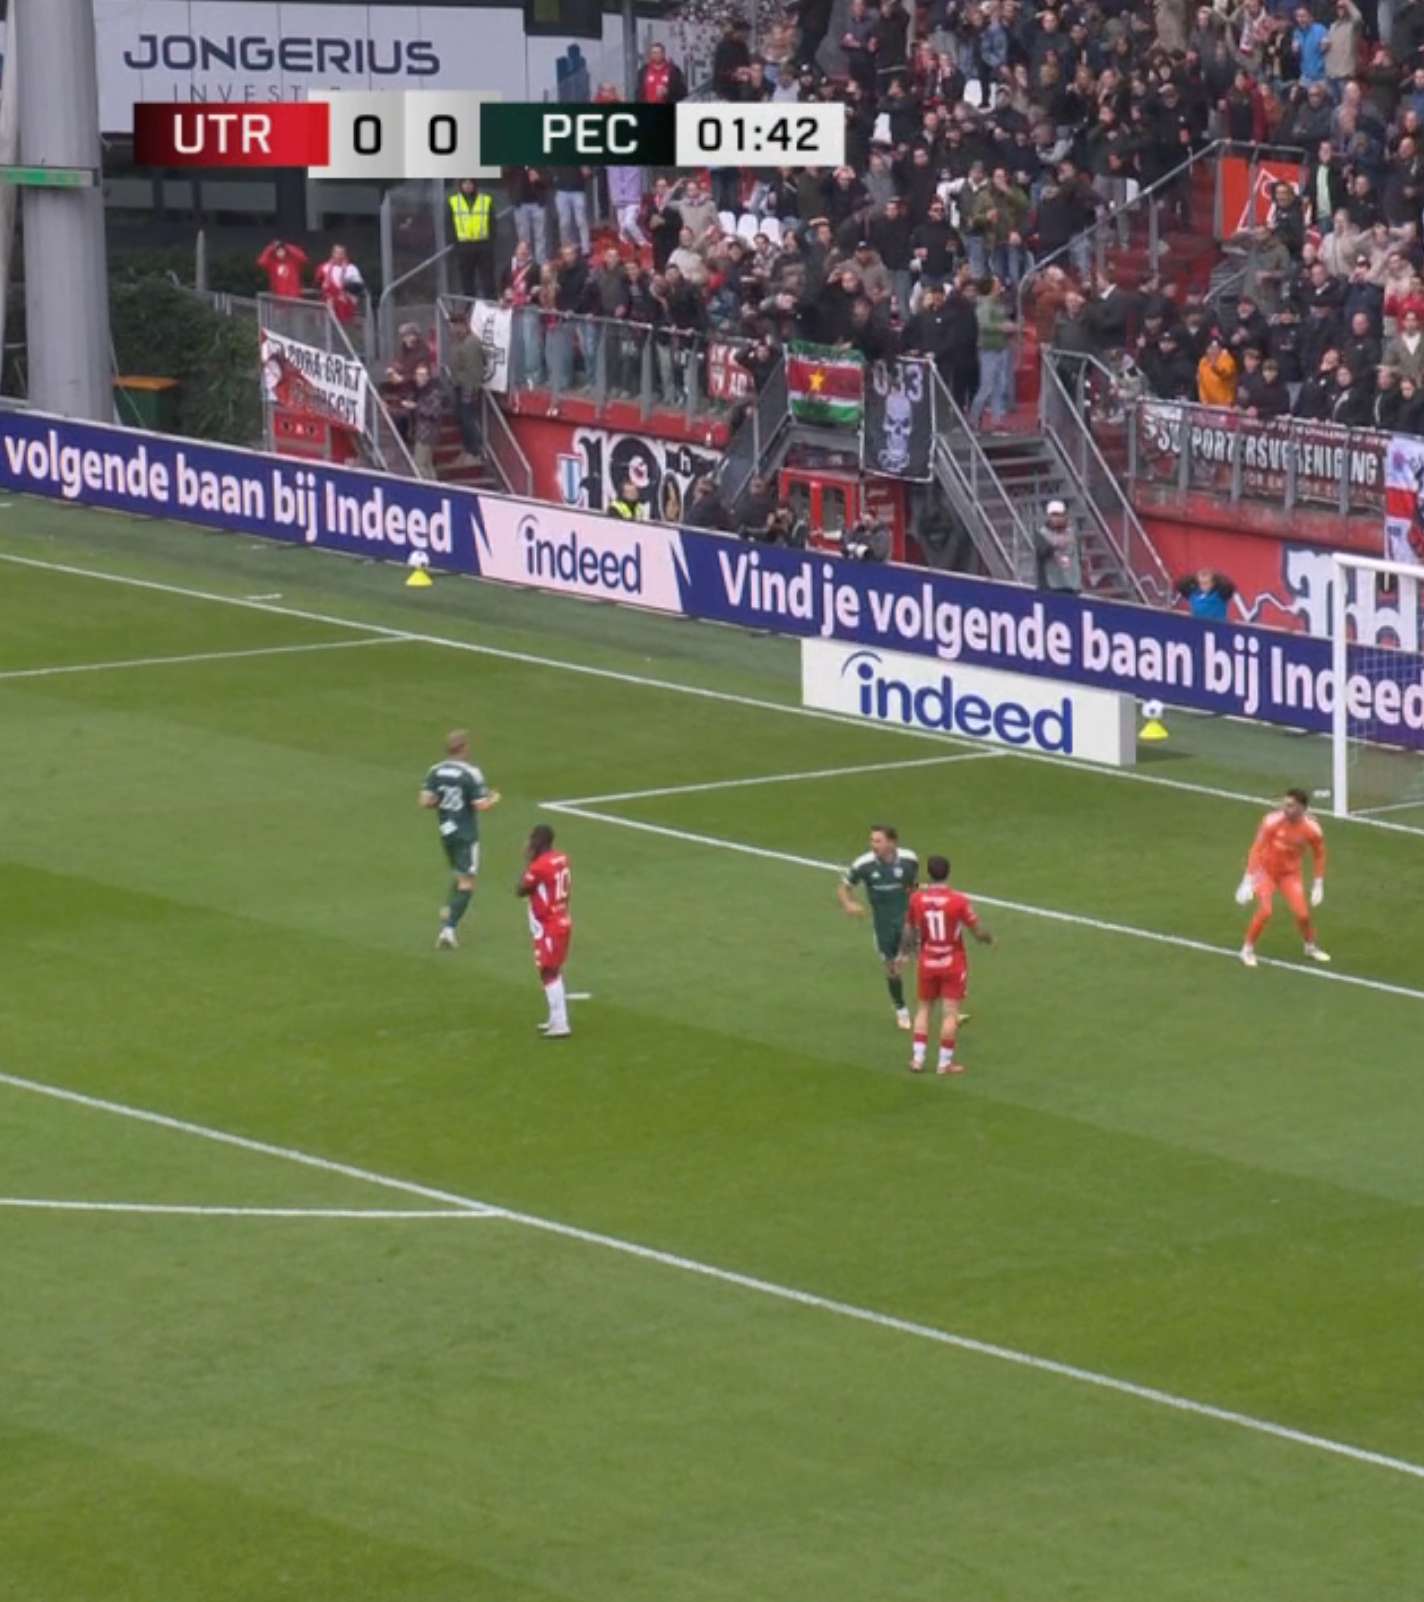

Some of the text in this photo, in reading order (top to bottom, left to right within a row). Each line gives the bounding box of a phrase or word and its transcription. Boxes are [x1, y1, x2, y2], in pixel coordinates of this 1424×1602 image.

[124, 35, 441, 76] JONGERIUS
[4, 430, 453, 553] volgende baan bij Indeed
[524, 524, 643, 594] indeed
[719, 550, 812, 620] Vind
[820, 563, 859, 638] je
[868, 583, 1072, 665] volgende
[1082, 610, 1193, 687] baan
[1204, 632, 1261, 715] bij
[855, 660, 1073, 755] indeed
[925, 910, 946, 941] 11
